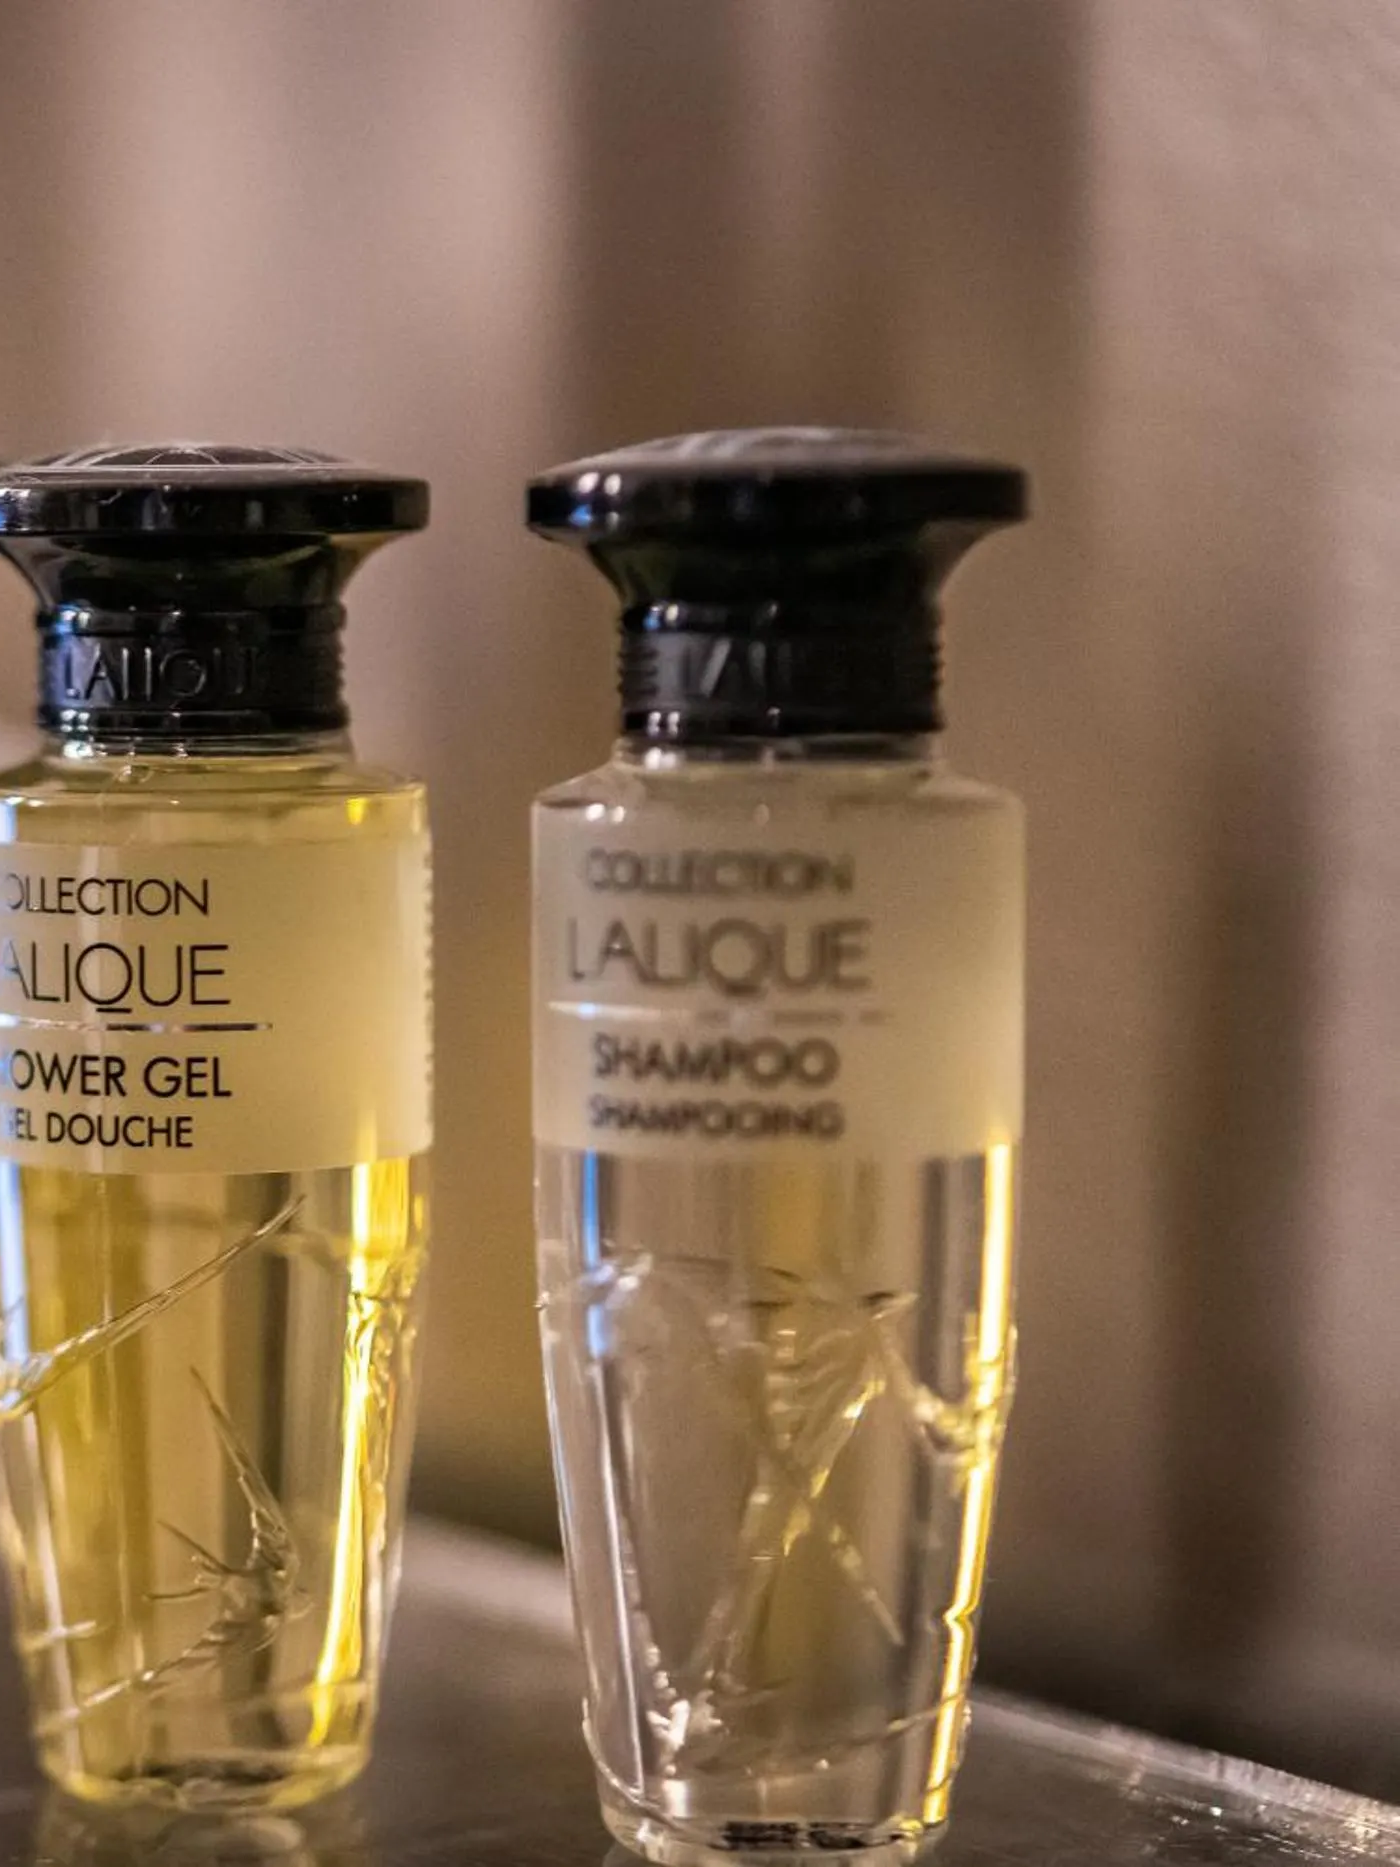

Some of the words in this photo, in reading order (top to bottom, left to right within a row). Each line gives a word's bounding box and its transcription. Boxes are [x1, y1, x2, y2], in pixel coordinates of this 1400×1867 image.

[63, 646, 262, 706] LALIQU
[585, 847, 855, 894] COLLECTION
[568, 916, 872, 997] LALIQUE
[143, 1056, 232, 1098] GEL
[593, 1031, 841, 1090] SHAMPOO
[46, 1112, 194, 1149] DOUCHE
[589, 1093, 846, 1139] SHAMPOOING
